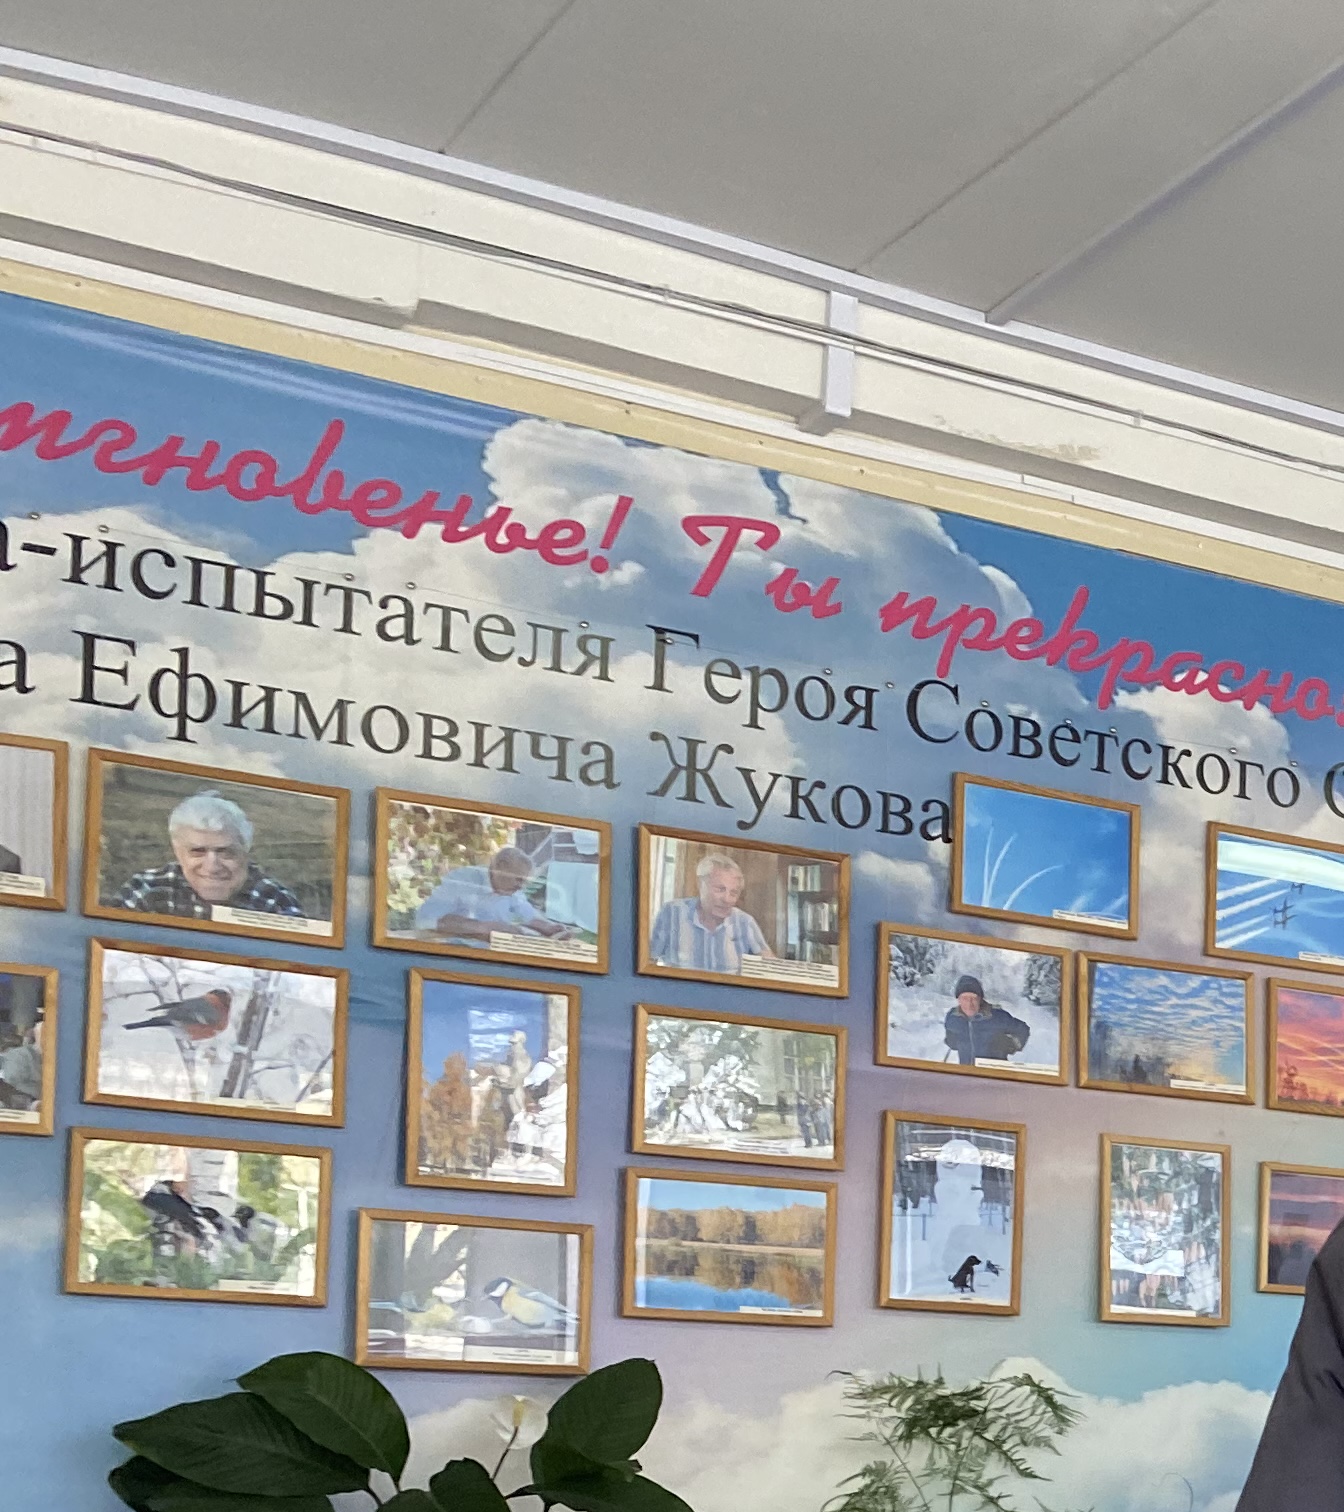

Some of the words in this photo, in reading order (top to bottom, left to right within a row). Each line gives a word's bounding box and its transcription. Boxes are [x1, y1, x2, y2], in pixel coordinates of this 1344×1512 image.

[681, 514, 842, 619] Ты
[69, 629, 621, 791] Ефимовича
[646, 731, 953, 844] Жукова
[644, 623, 879, 731] Героя
[906, 679, 1300, 808] Советского
